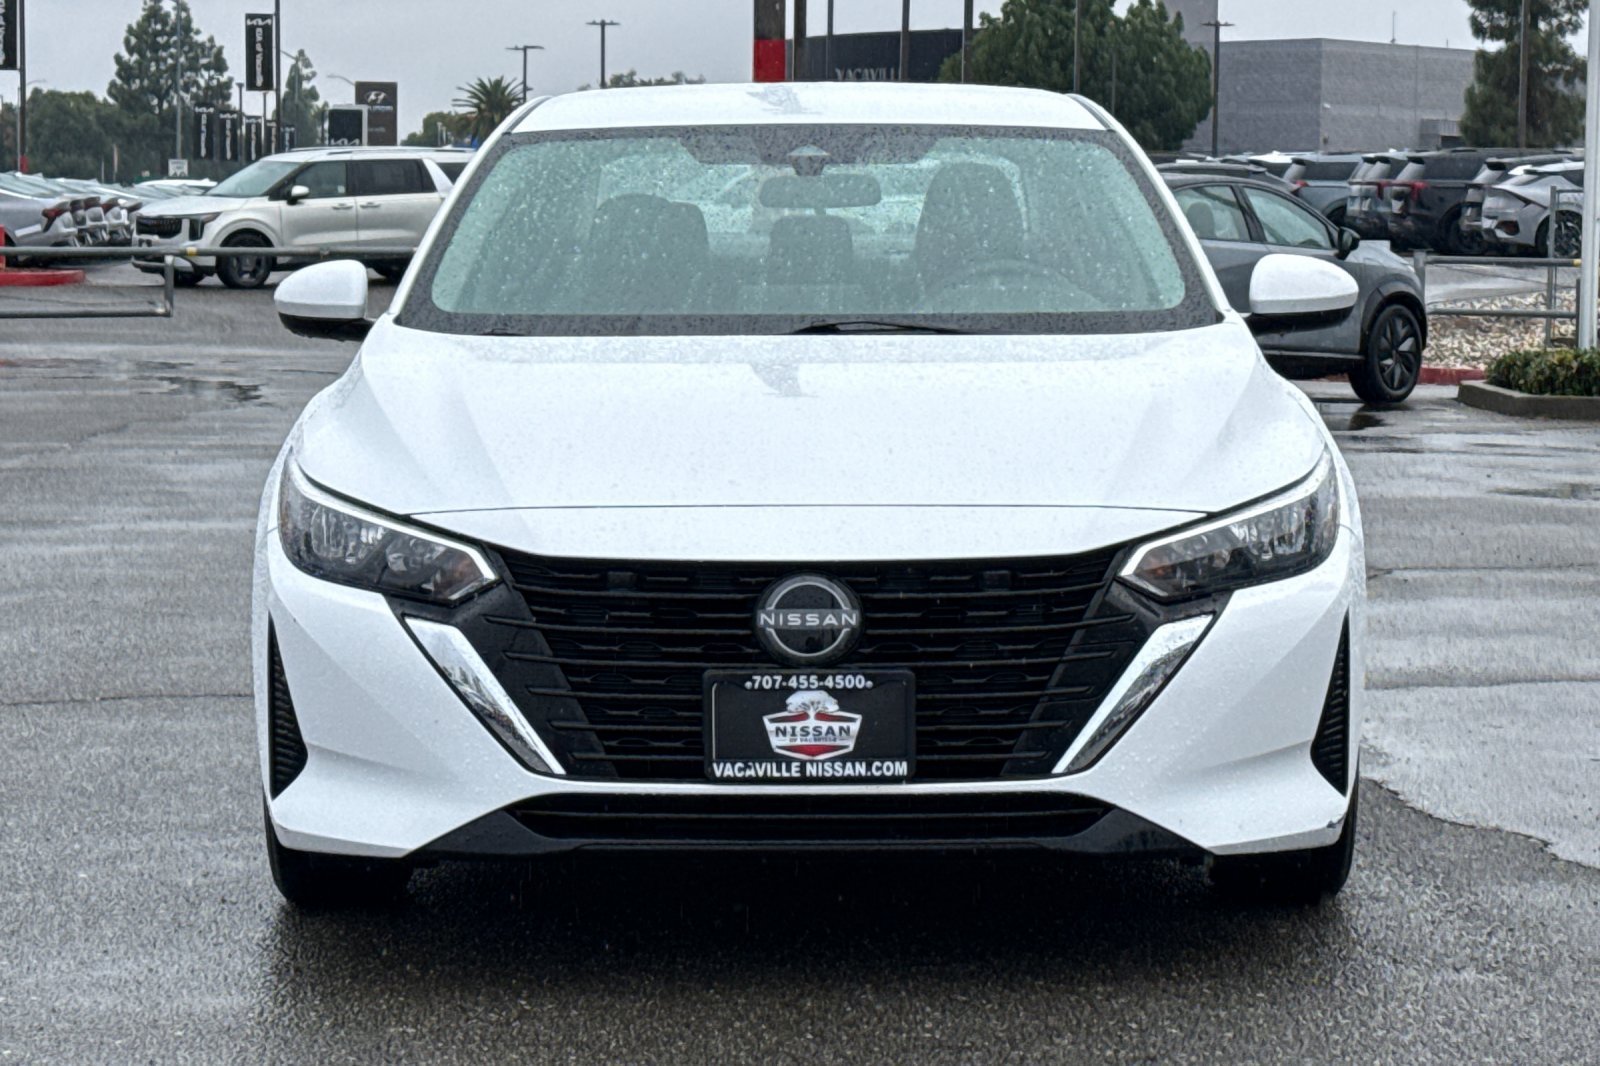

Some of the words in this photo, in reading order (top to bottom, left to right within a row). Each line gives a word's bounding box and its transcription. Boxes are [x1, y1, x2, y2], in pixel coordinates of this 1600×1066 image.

[759, 612, 857, 627] NISSAN
[751, 675, 866, 690] 707-455-4500
[775, 725, 851, 738] NISSAN
[712, 762, 801, 778] VACAVILLE
[805, 761, 908, 778] NISSAN.COM
